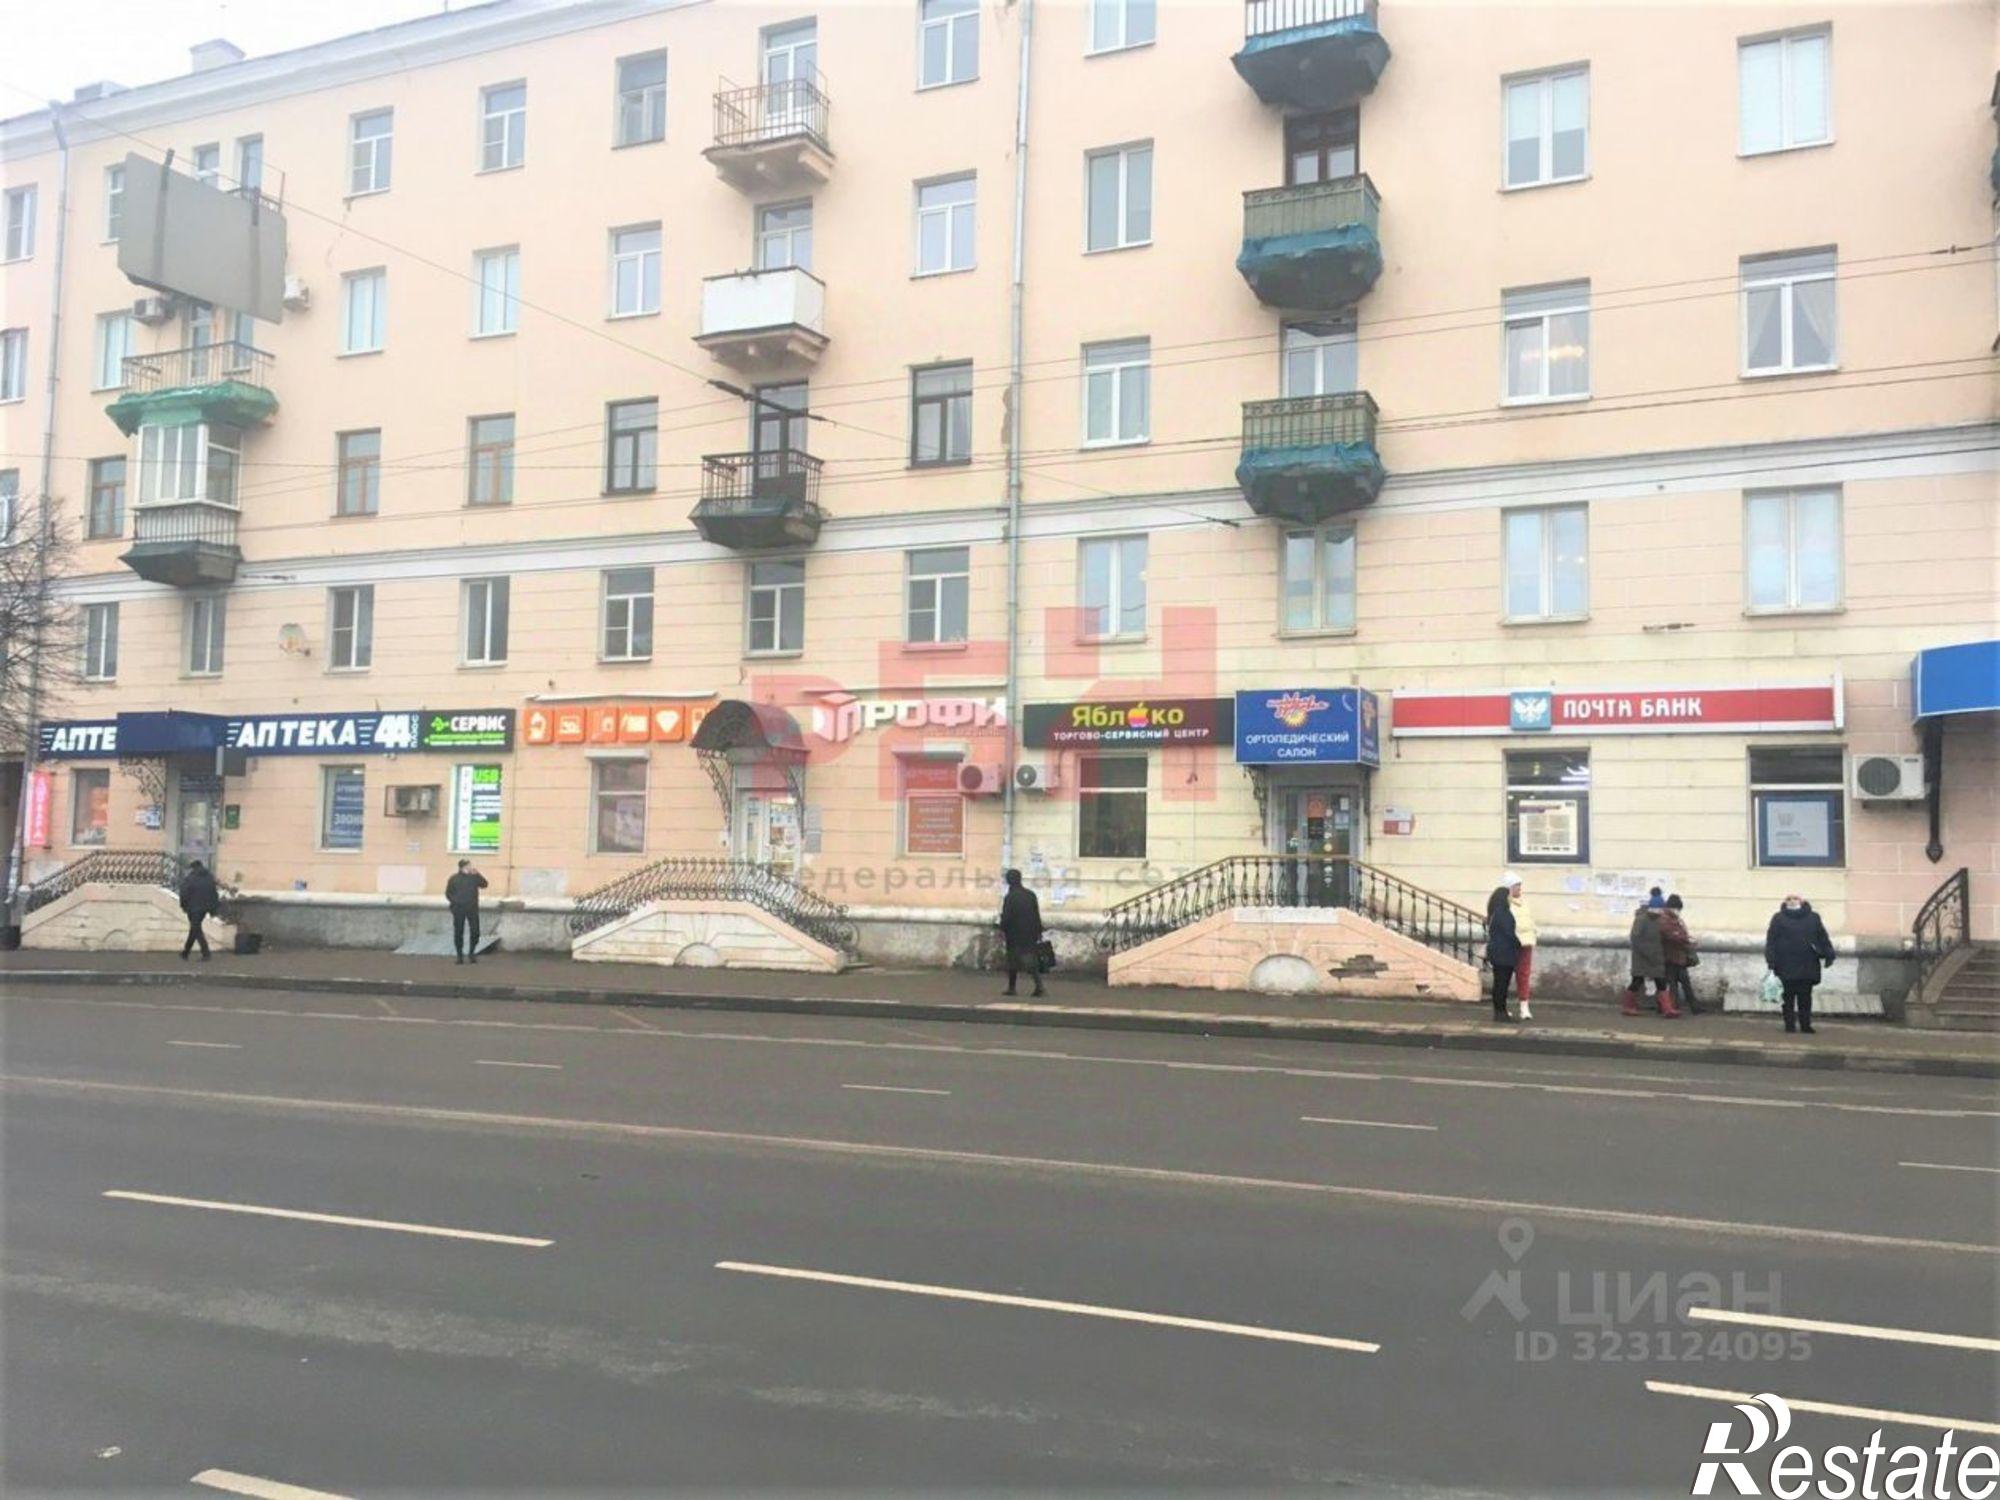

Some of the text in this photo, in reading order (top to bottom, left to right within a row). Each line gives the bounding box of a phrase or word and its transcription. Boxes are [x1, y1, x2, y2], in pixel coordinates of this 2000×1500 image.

[1563, 697, 1702, 719] ПОЧТА БАНК
[236, 720, 357, 748] АПТЕКА
[374, 715, 411, 748] 44
[451, 715, 507, 732] СЕРВИС
[51, 727, 117, 751] АПТЕ
[1054, 728, 1209, 741] ТОРГОВО-СЕРВИСНЫЙ ЦЕНТР
[1245, 731, 1349, 745] ОРТОПЕДИЧЕСКИЙ
[1277, 748, 1317, 758] САЛОН
